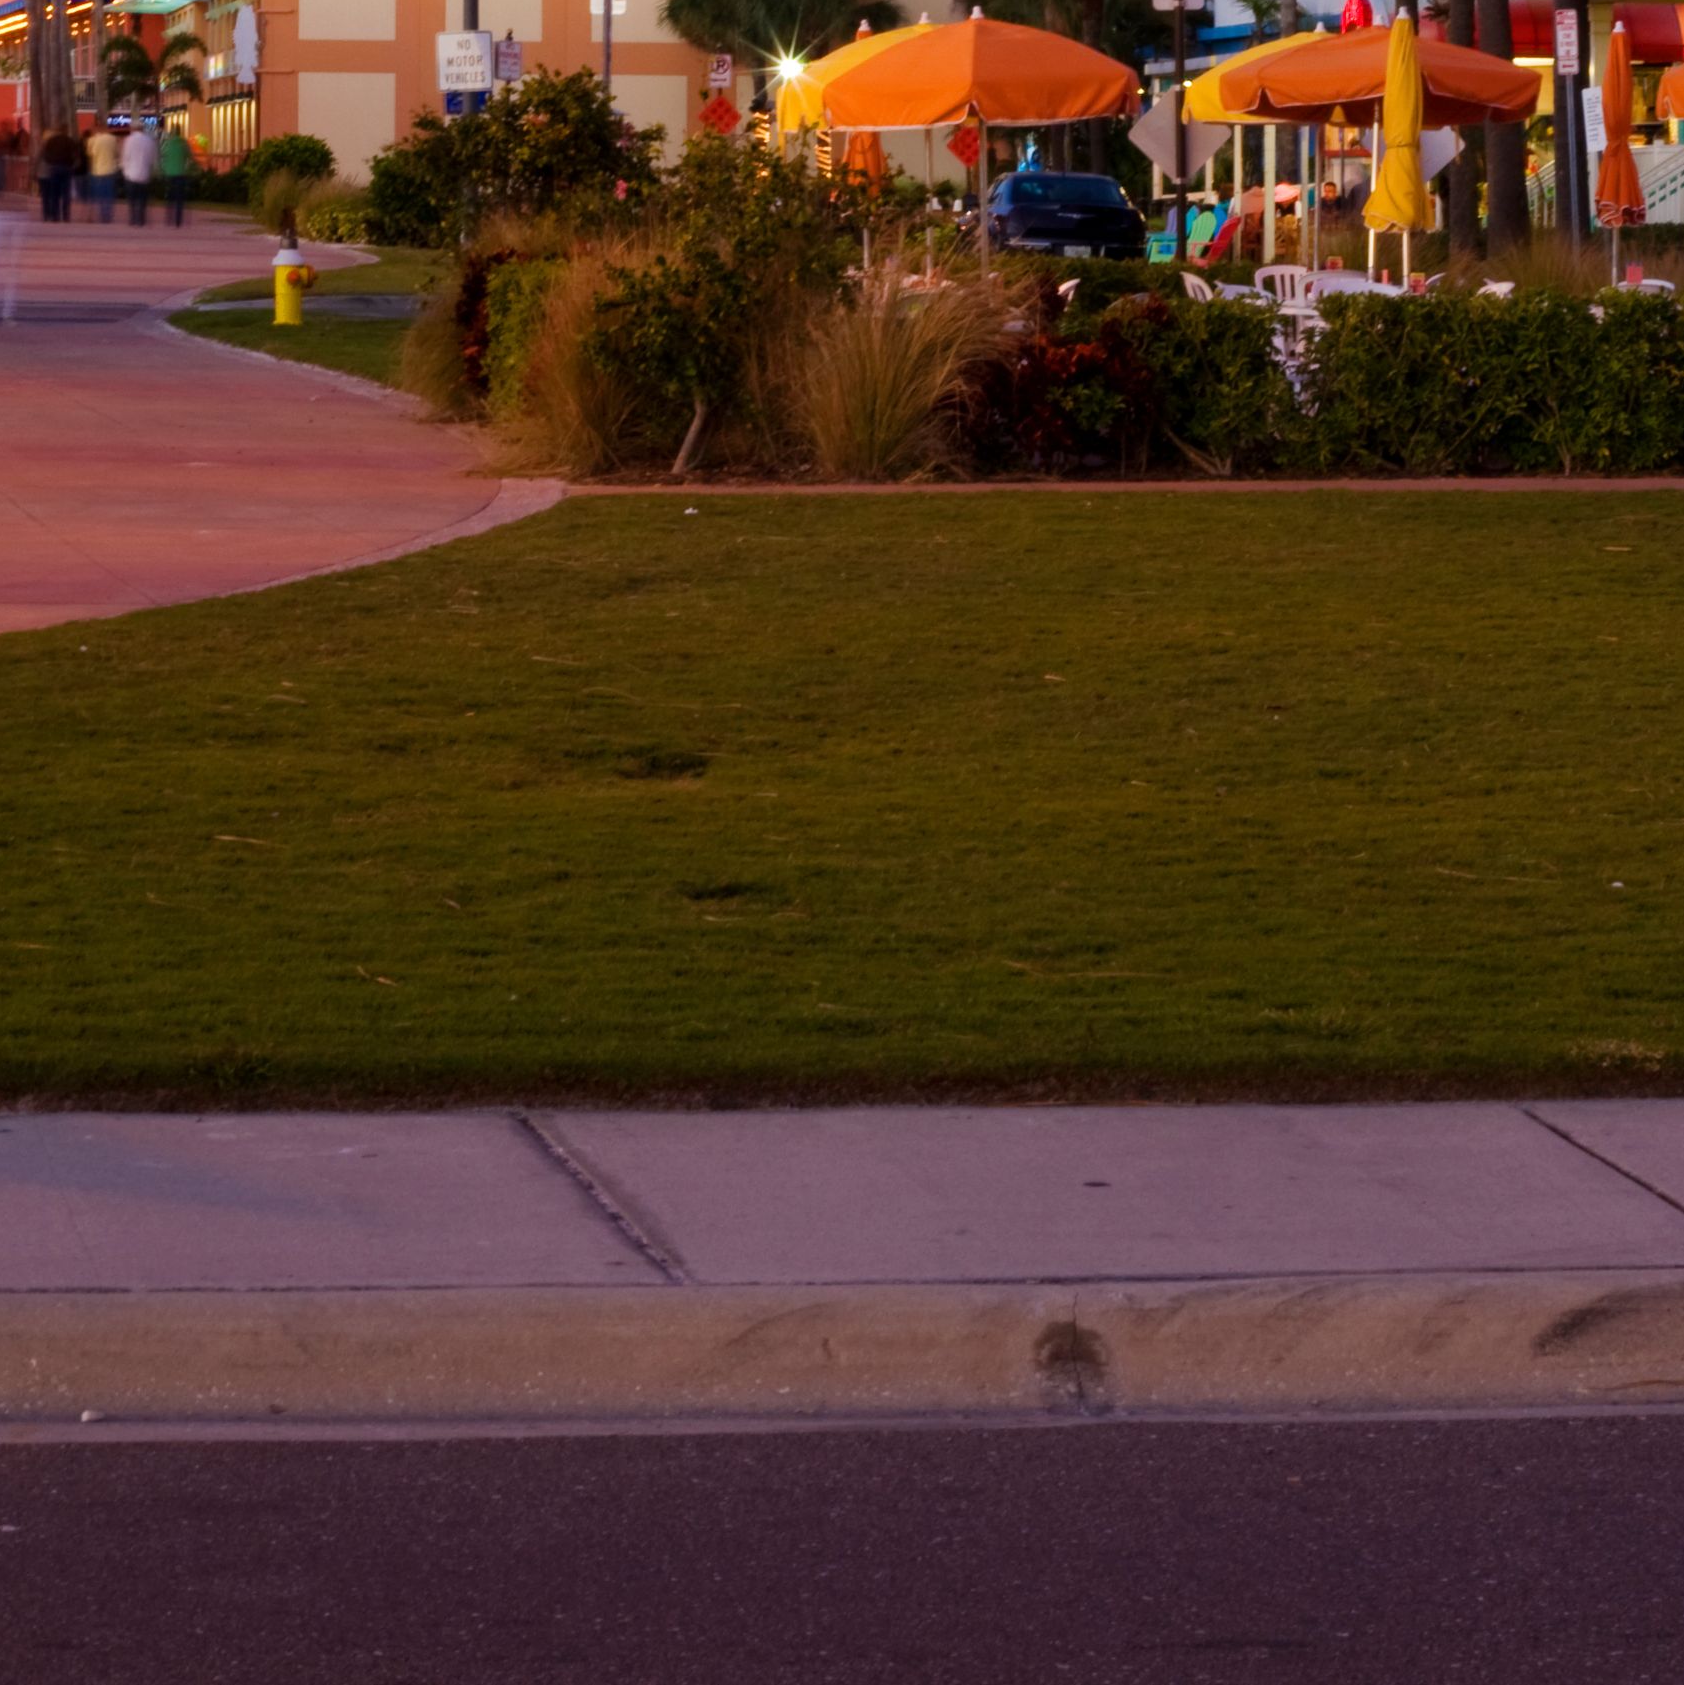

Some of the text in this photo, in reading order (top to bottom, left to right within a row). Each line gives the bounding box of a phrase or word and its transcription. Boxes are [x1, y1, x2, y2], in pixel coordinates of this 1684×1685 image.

[456, 39, 471, 51] NO
[446, 55, 484, 67] MOTOR
[444, 71, 486, 84] VEHICLES
